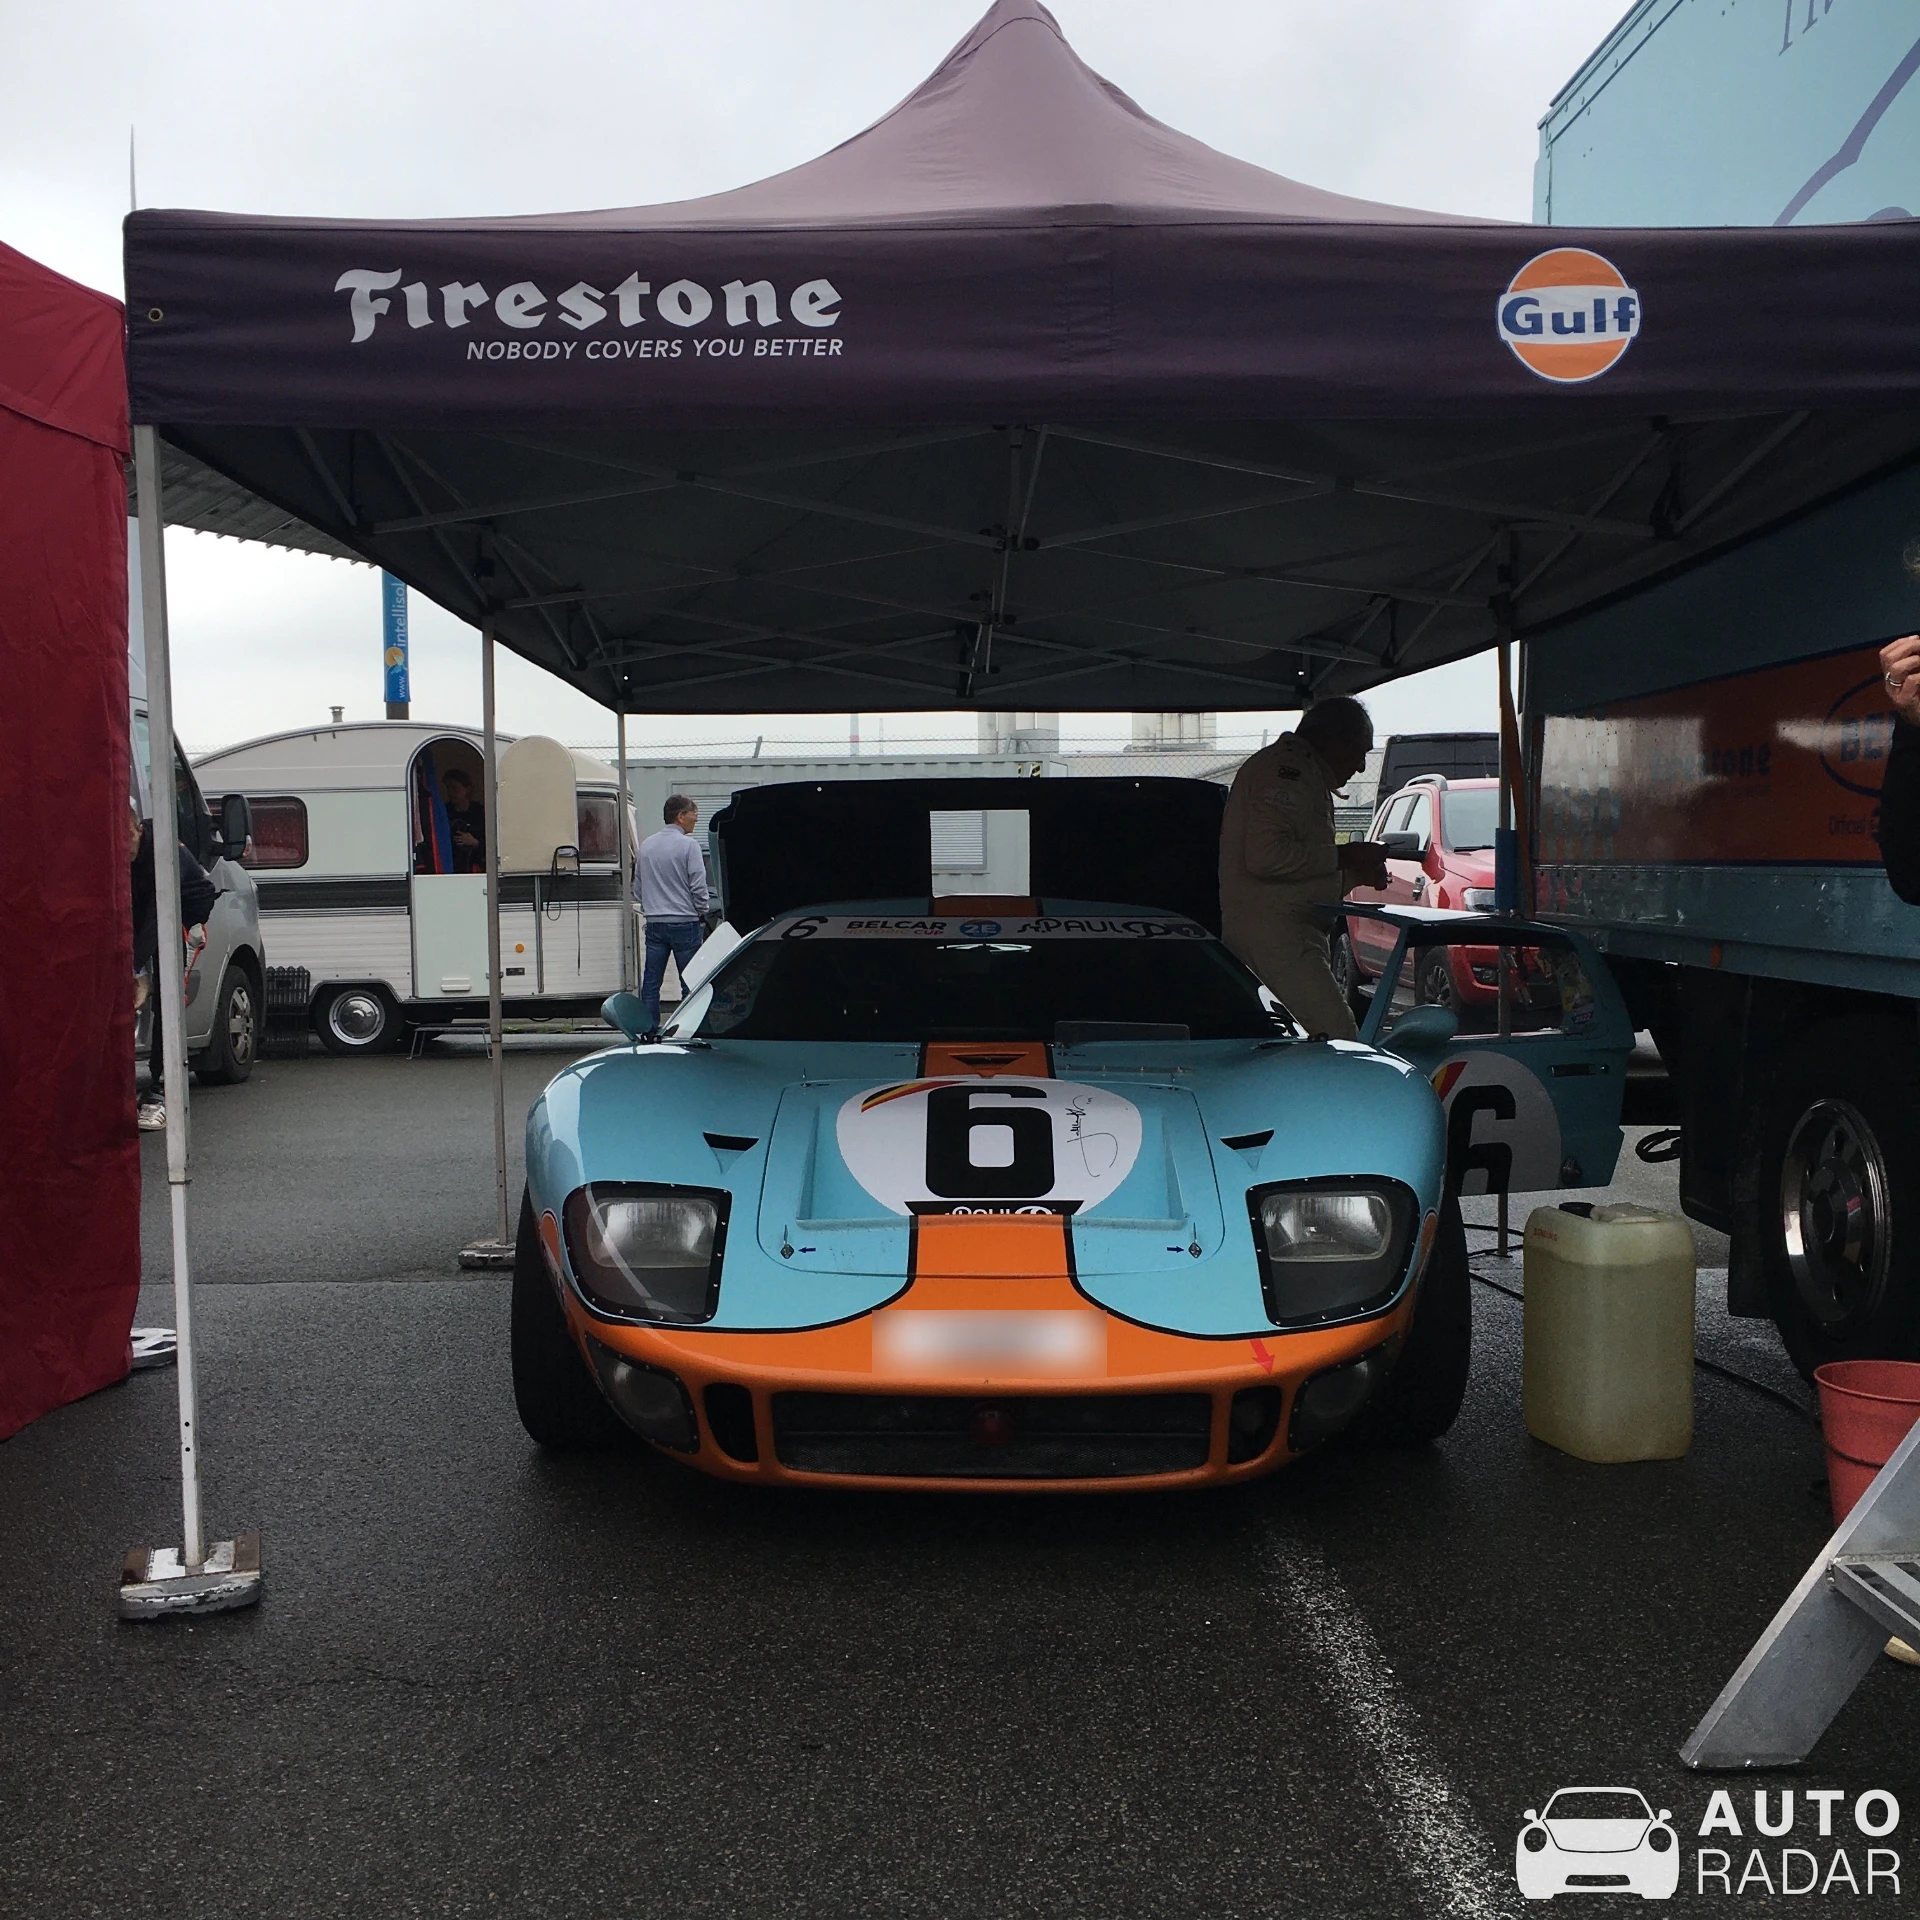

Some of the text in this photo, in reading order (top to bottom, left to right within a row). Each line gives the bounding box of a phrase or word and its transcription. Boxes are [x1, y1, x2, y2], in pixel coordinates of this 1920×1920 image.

[334, 268, 843, 343] Firestone
[1501, 296, 1636, 336] Gulf
[466, 338, 844, 360] NOBODY COVERS YOU BETTER
[780, 916, 828, 940] 6
[845, 920, 947, 931] BELCAR
[925, 1085, 1056, 1200] 6
[1447, 1085, 1516, 1197] 6
